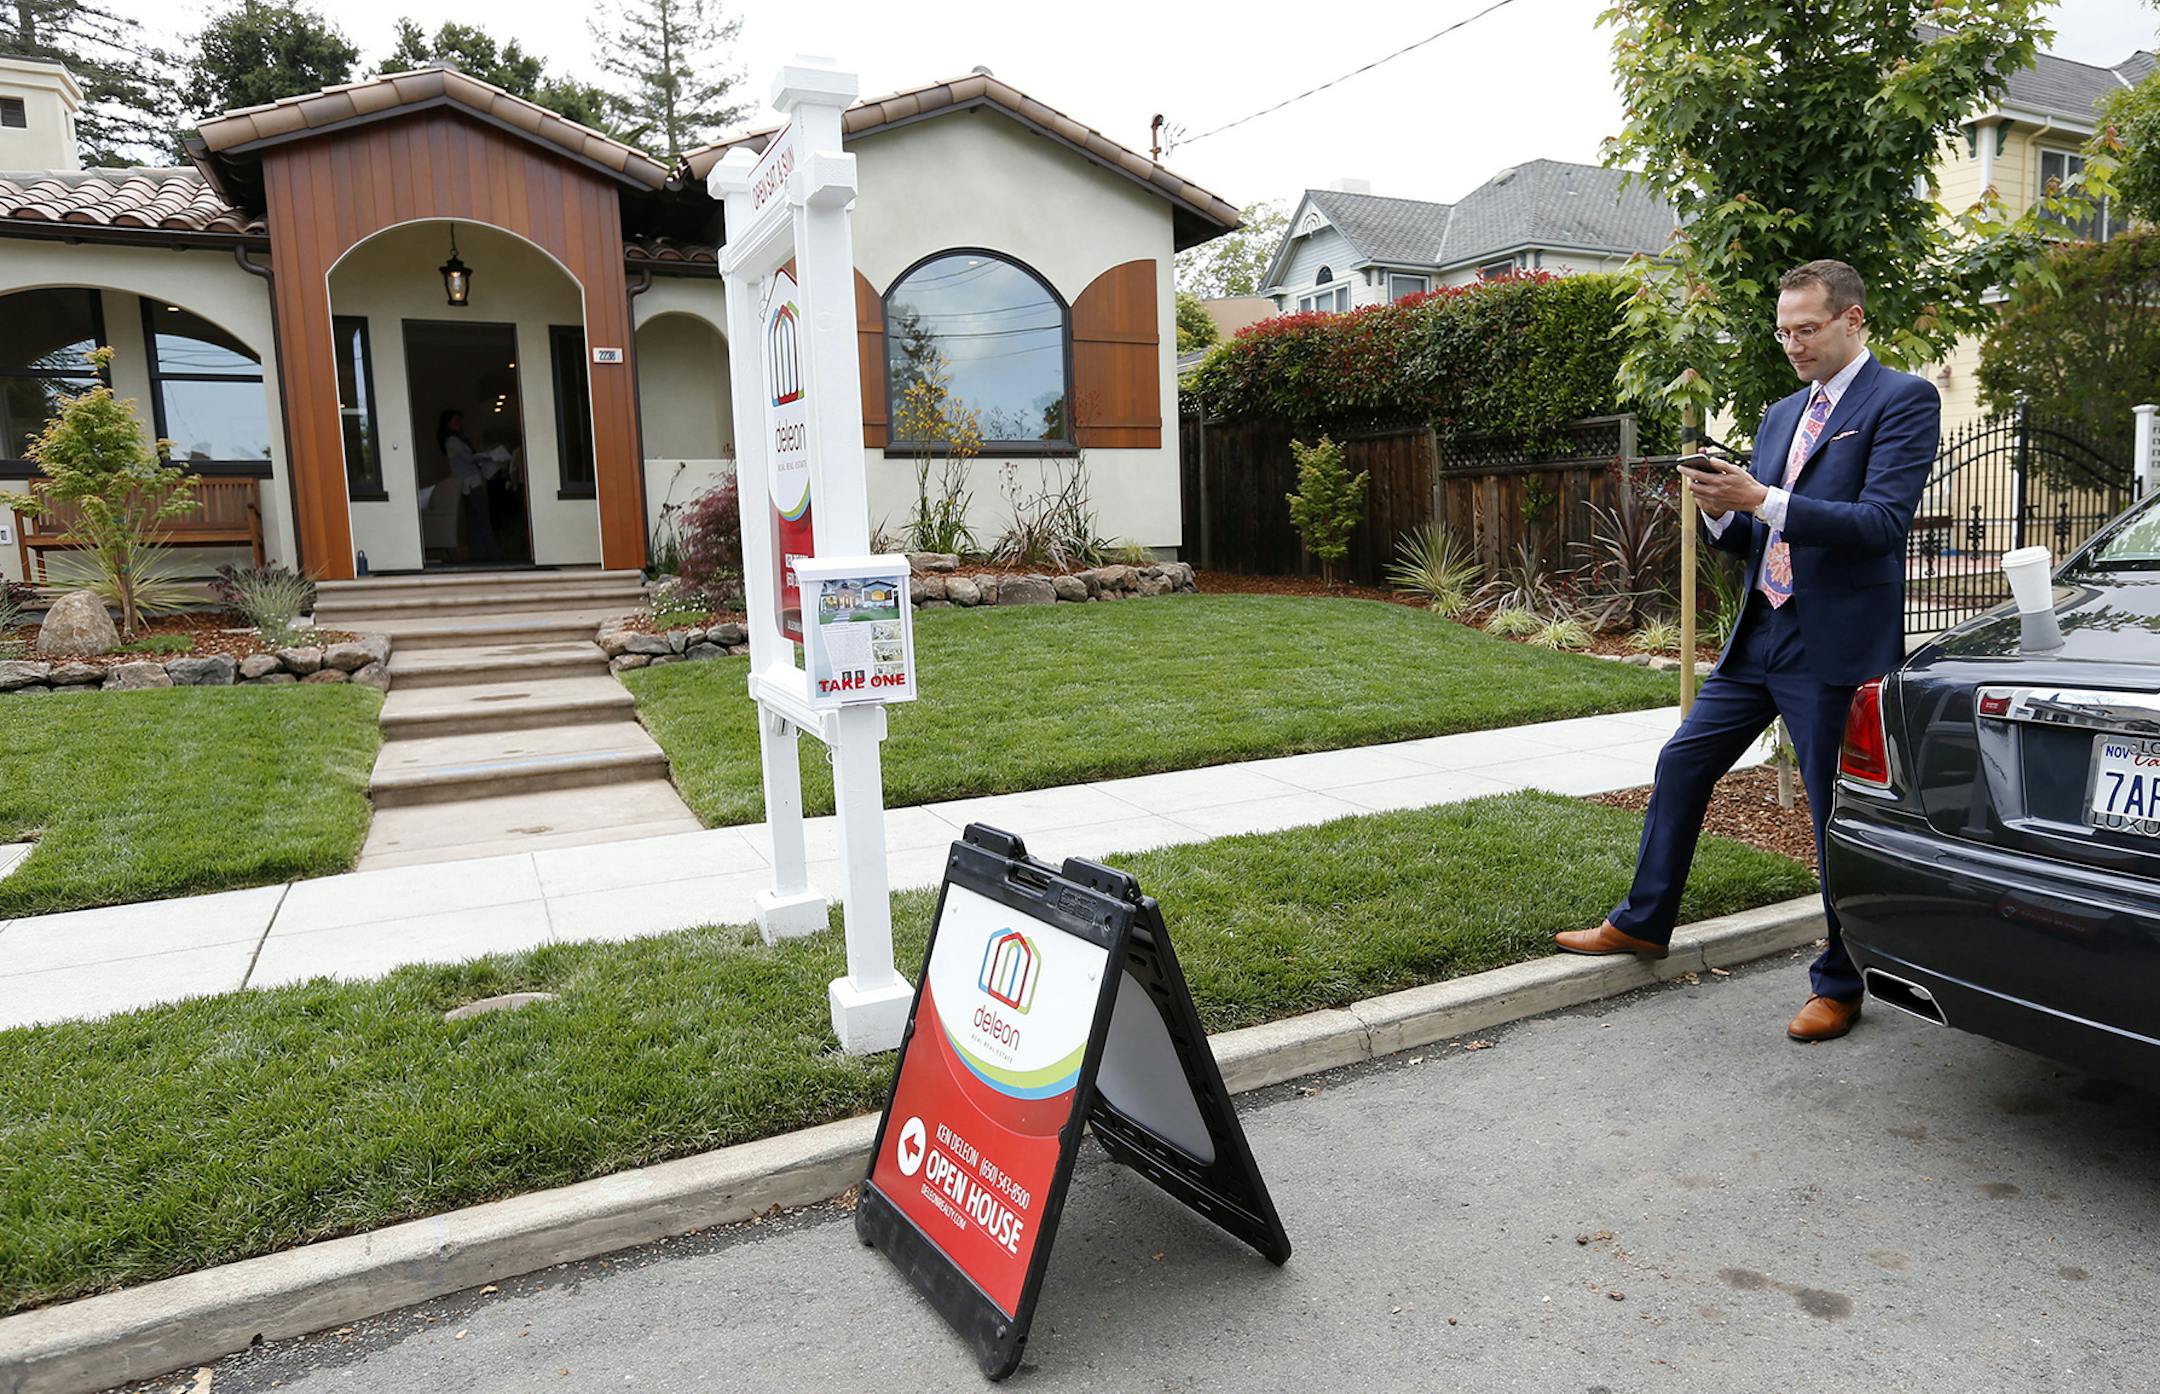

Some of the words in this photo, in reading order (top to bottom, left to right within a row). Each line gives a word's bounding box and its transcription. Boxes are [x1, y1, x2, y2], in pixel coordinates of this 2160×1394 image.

[752, 176, 768, 211] OPEN
[766, 163, 779, 196] SAT
[775, 418, 807, 453] deleon
[818, 677, 866, 693] TAKE
[870, 673, 906, 688] ONE
[2105, 745, 2130, 759] NOV
[974, 1004, 1020, 1051] deleon
[936, 1122, 952, 1146] KEN
[950, 1133, 980, 1168] DELEON
[979, 1157, 998, 1187] (650)
[996, 1171, 1030, 1210] 543-8500
[925, 1149, 969, 1205] OPEN
[965, 1182, 1024, 1254] HOUSE
